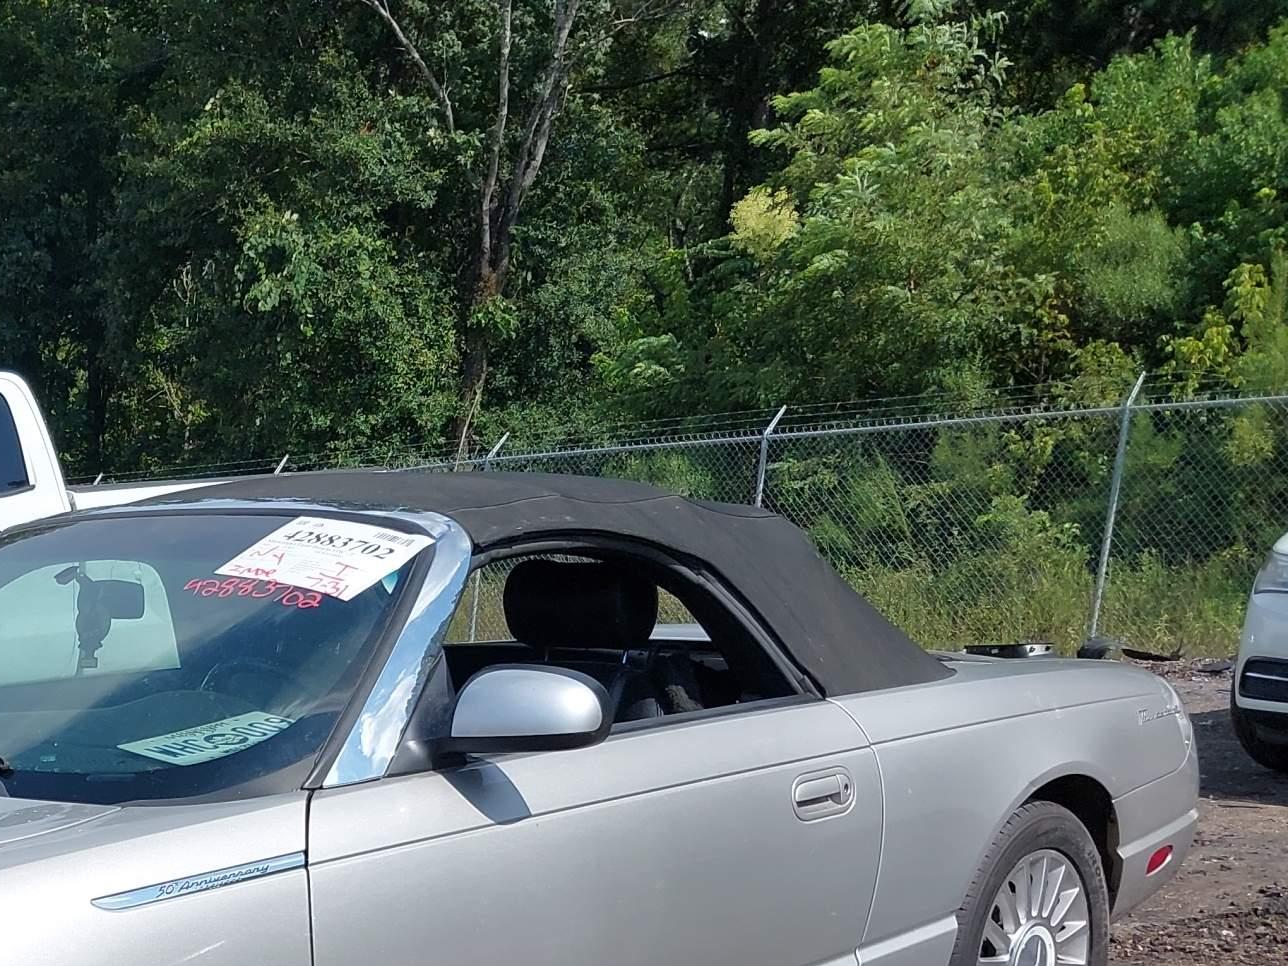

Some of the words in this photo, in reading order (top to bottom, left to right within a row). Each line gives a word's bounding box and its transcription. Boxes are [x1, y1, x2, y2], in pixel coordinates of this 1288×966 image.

[283, 529, 396, 560] 42883702
[183, 577, 323, 609] 42883702
[178, 864, 270, 893] Anniversary
